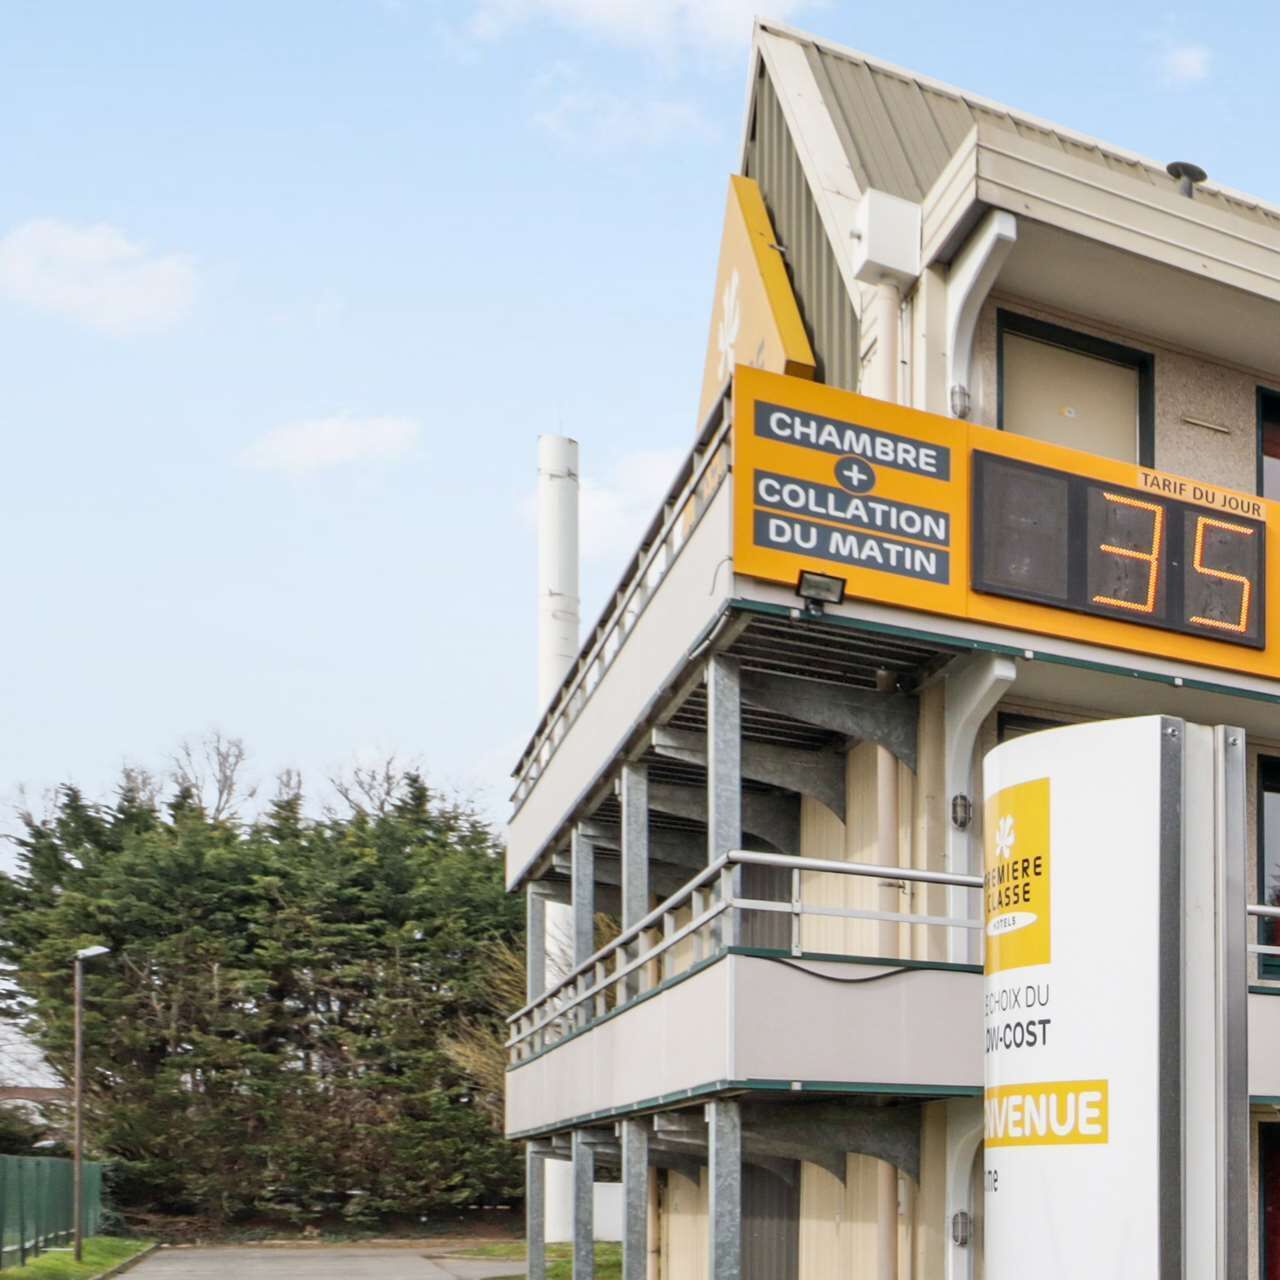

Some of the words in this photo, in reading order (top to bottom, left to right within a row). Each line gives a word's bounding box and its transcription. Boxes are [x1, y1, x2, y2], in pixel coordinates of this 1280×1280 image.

[769, 412, 937, 473] CHAMBRE
[758, 478, 946, 541] COLLATION
[1142, 472, 1188, 496] TARIF
[1193, 487, 1216, 504] DU
[1221, 495, 1262, 518] JOUR
[768, 518, 817, 549] DU
[829, 532, 937, 575] MATIN
[1092, 491, 1254, 633] 35
[1025, 983, 1050, 1008] DU
[986, 1018, 1052, 1054] OW-COST
